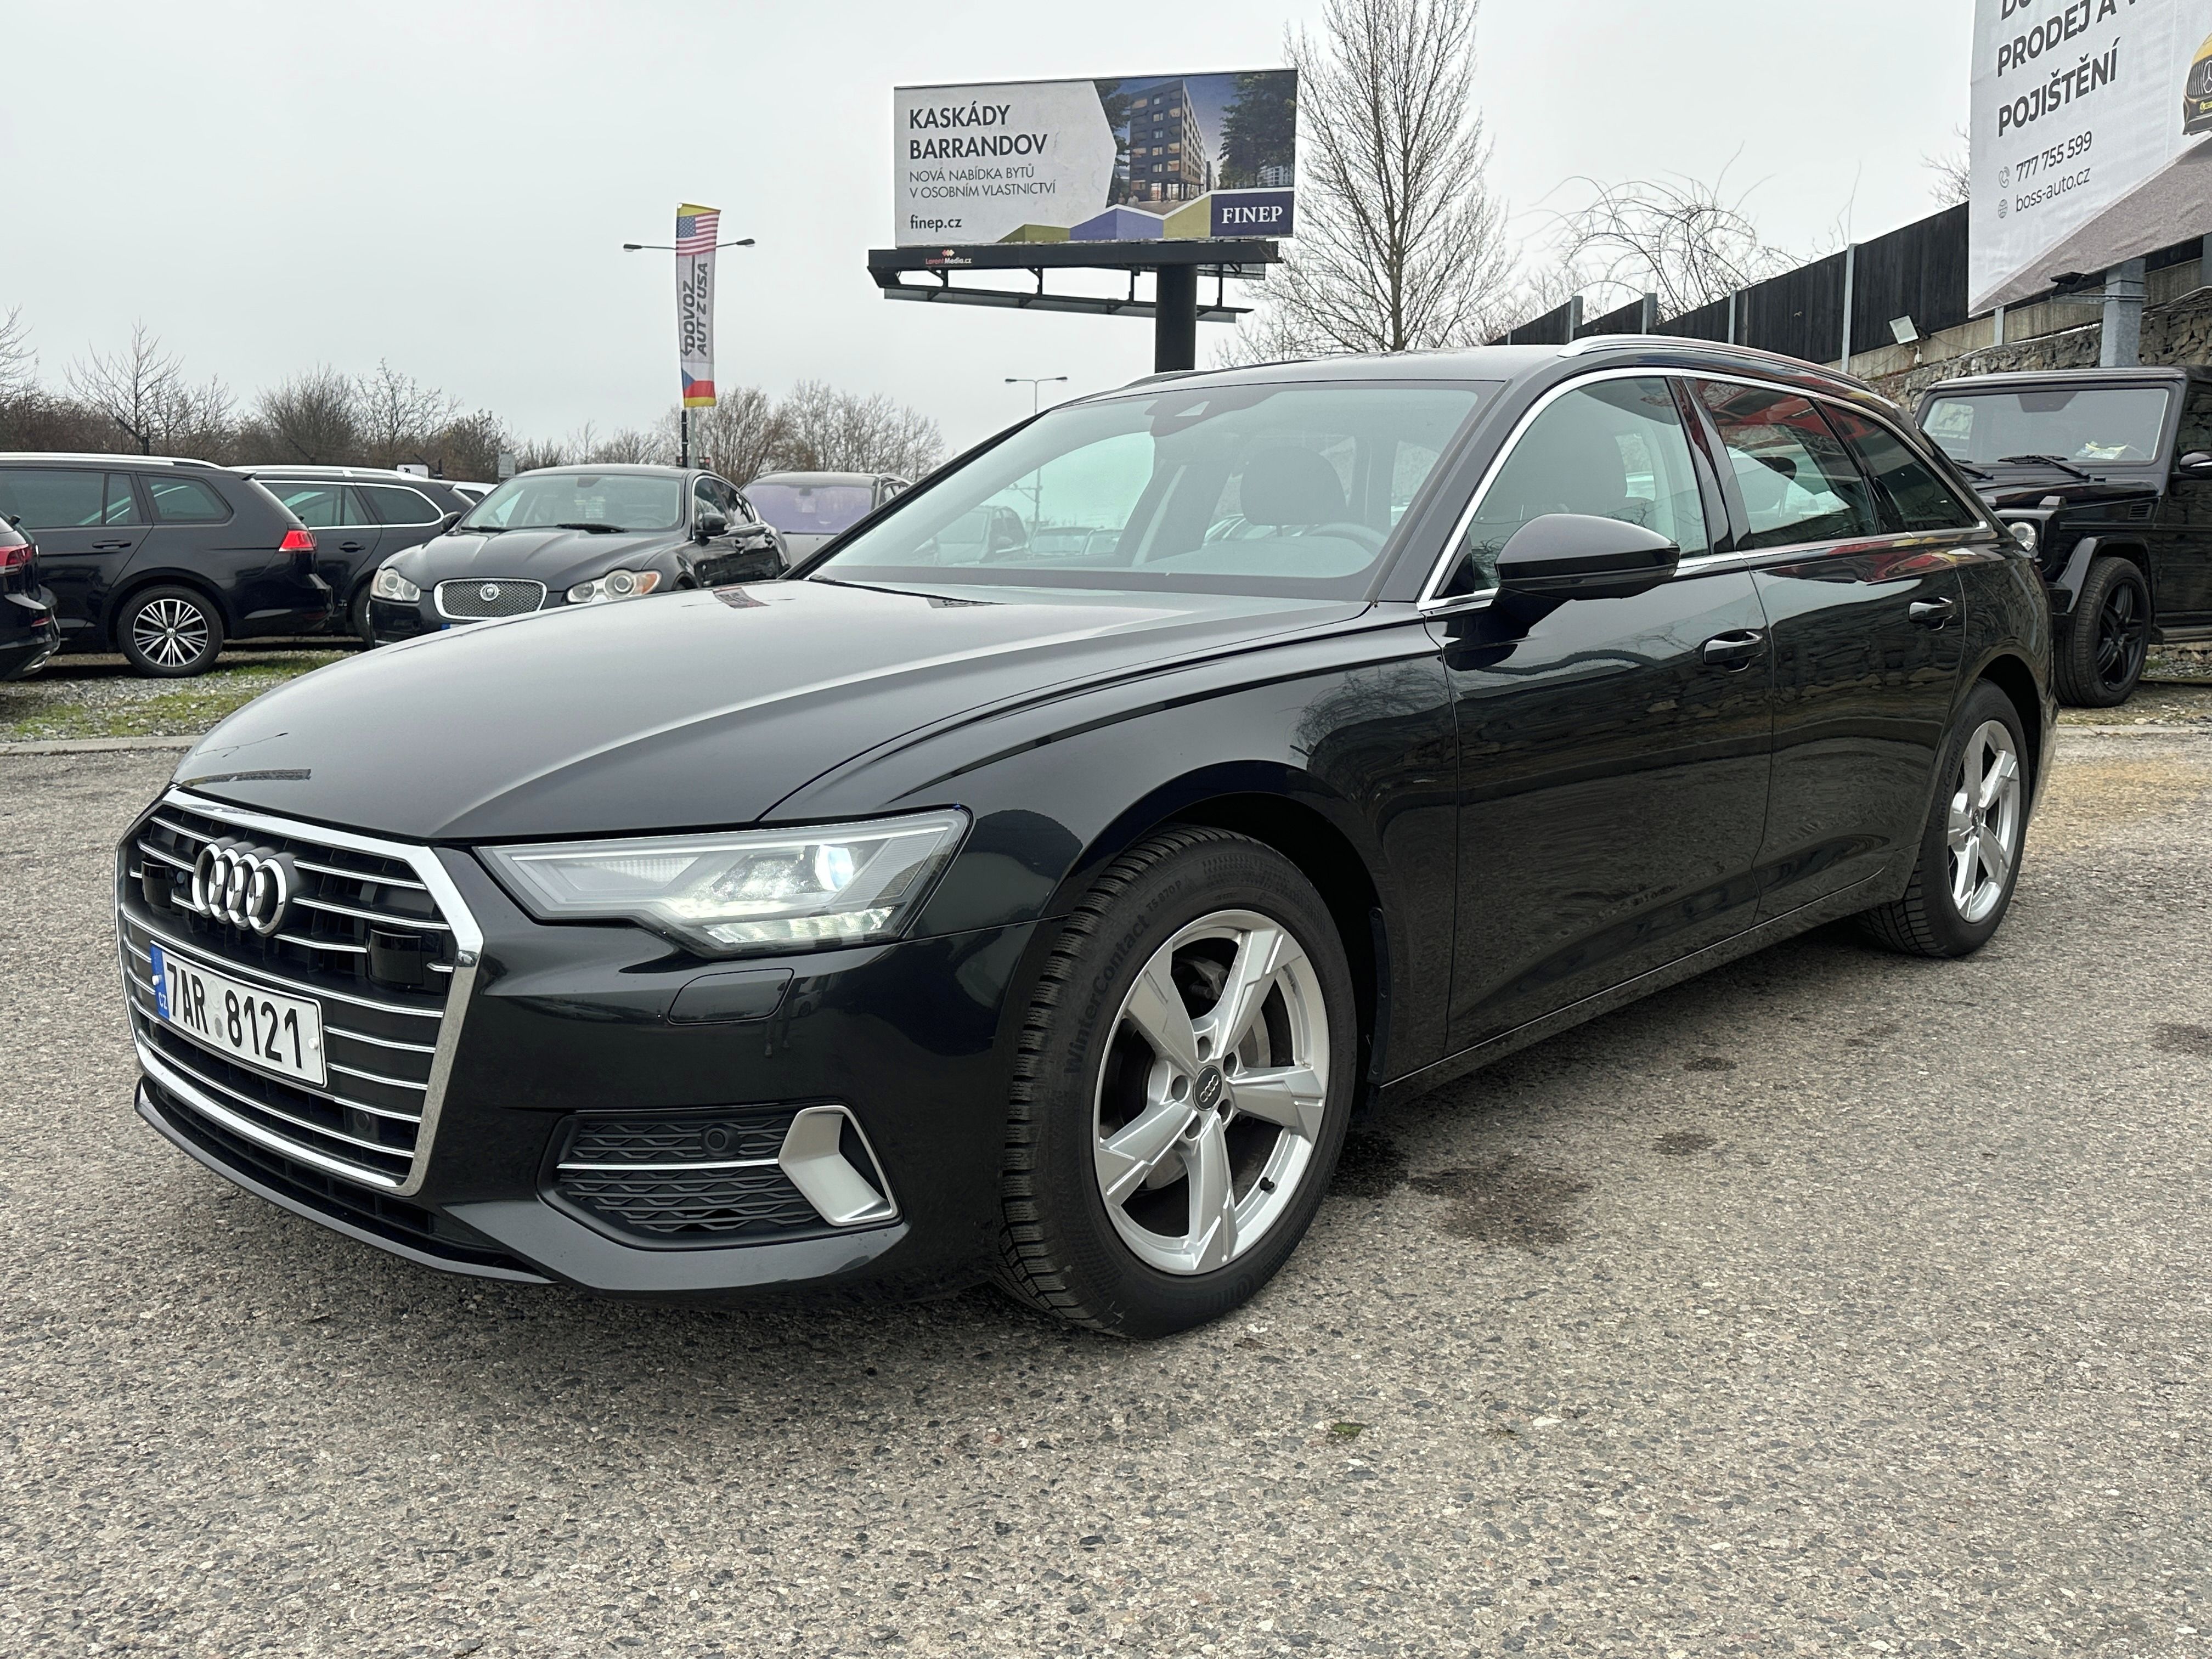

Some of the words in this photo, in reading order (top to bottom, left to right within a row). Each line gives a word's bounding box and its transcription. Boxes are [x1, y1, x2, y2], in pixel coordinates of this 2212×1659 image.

[1998, 0, 2091, 77] PRODEJ
[1999, 36, 2121, 137] POJIŠTĚNÍ
[910, 100, 1011, 129] KASKÁDY
[910, 134, 1048, 160] BARRANDOV
[2016, 155, 2039, 182] 777
[2042, 143, 2064, 171] 755
[2067, 131, 2092, 159] 599
[909, 187, 918, 199] V
[921, 183, 979, 198] OSOBNÍM
[981, 179, 1057, 196] VLASTNICTVÍ
[910, 167, 946, 183] NOVÁ
[949, 166, 1003, 181] NABÍDKA
[1006, 163, 1035, 179] BYTŮ
[2016, 167, 2091, 213] boss-auto.cz
[910, 215, 962, 233] finep.cz
[1221, 206, 1283, 224] FINEP
[696, 263, 708, 299] USA
[682, 280, 696, 348] DOVOZ
[696, 301, 707, 315] Z
[696, 317, 707, 357] AUT
[158, 991, 168, 1010] CZ
[1063, 913, 1150, 1074] WinterContact
[166, 962, 209, 1035] 7AR
[225, 989, 302, 1069] 8121
